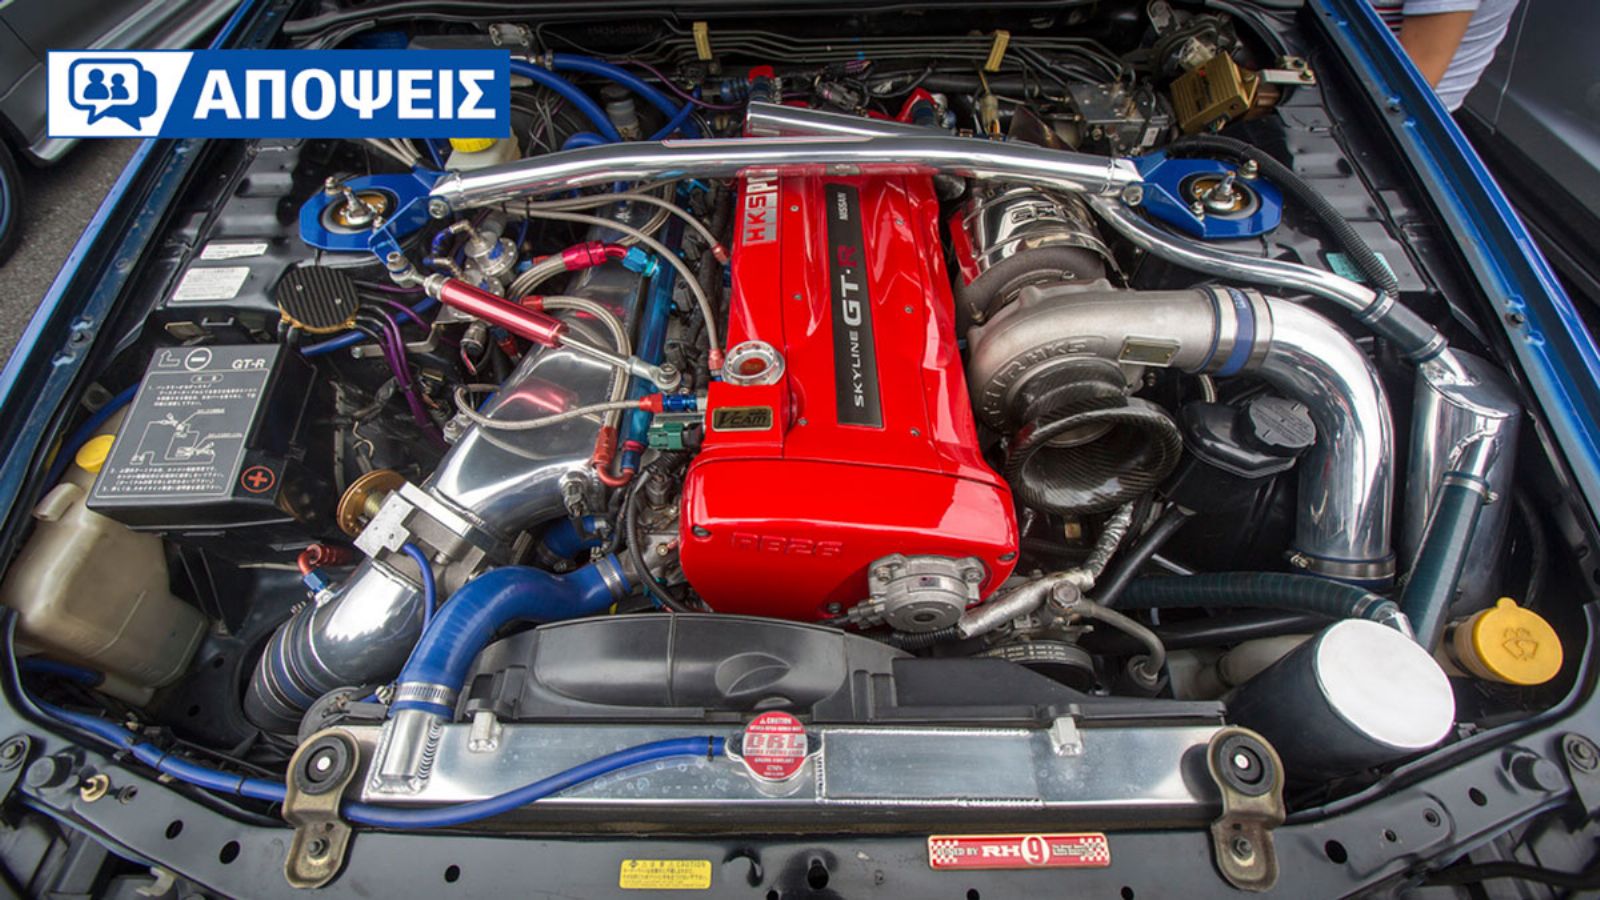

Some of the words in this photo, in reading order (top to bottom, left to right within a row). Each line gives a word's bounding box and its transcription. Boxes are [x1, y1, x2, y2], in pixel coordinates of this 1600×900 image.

[837, 191, 848, 220] NISSAN
[232, 358, 266, 370] GT-R
[849, 330, 864, 408] SKYLINE
[746, 733, 805, 749] DRL
